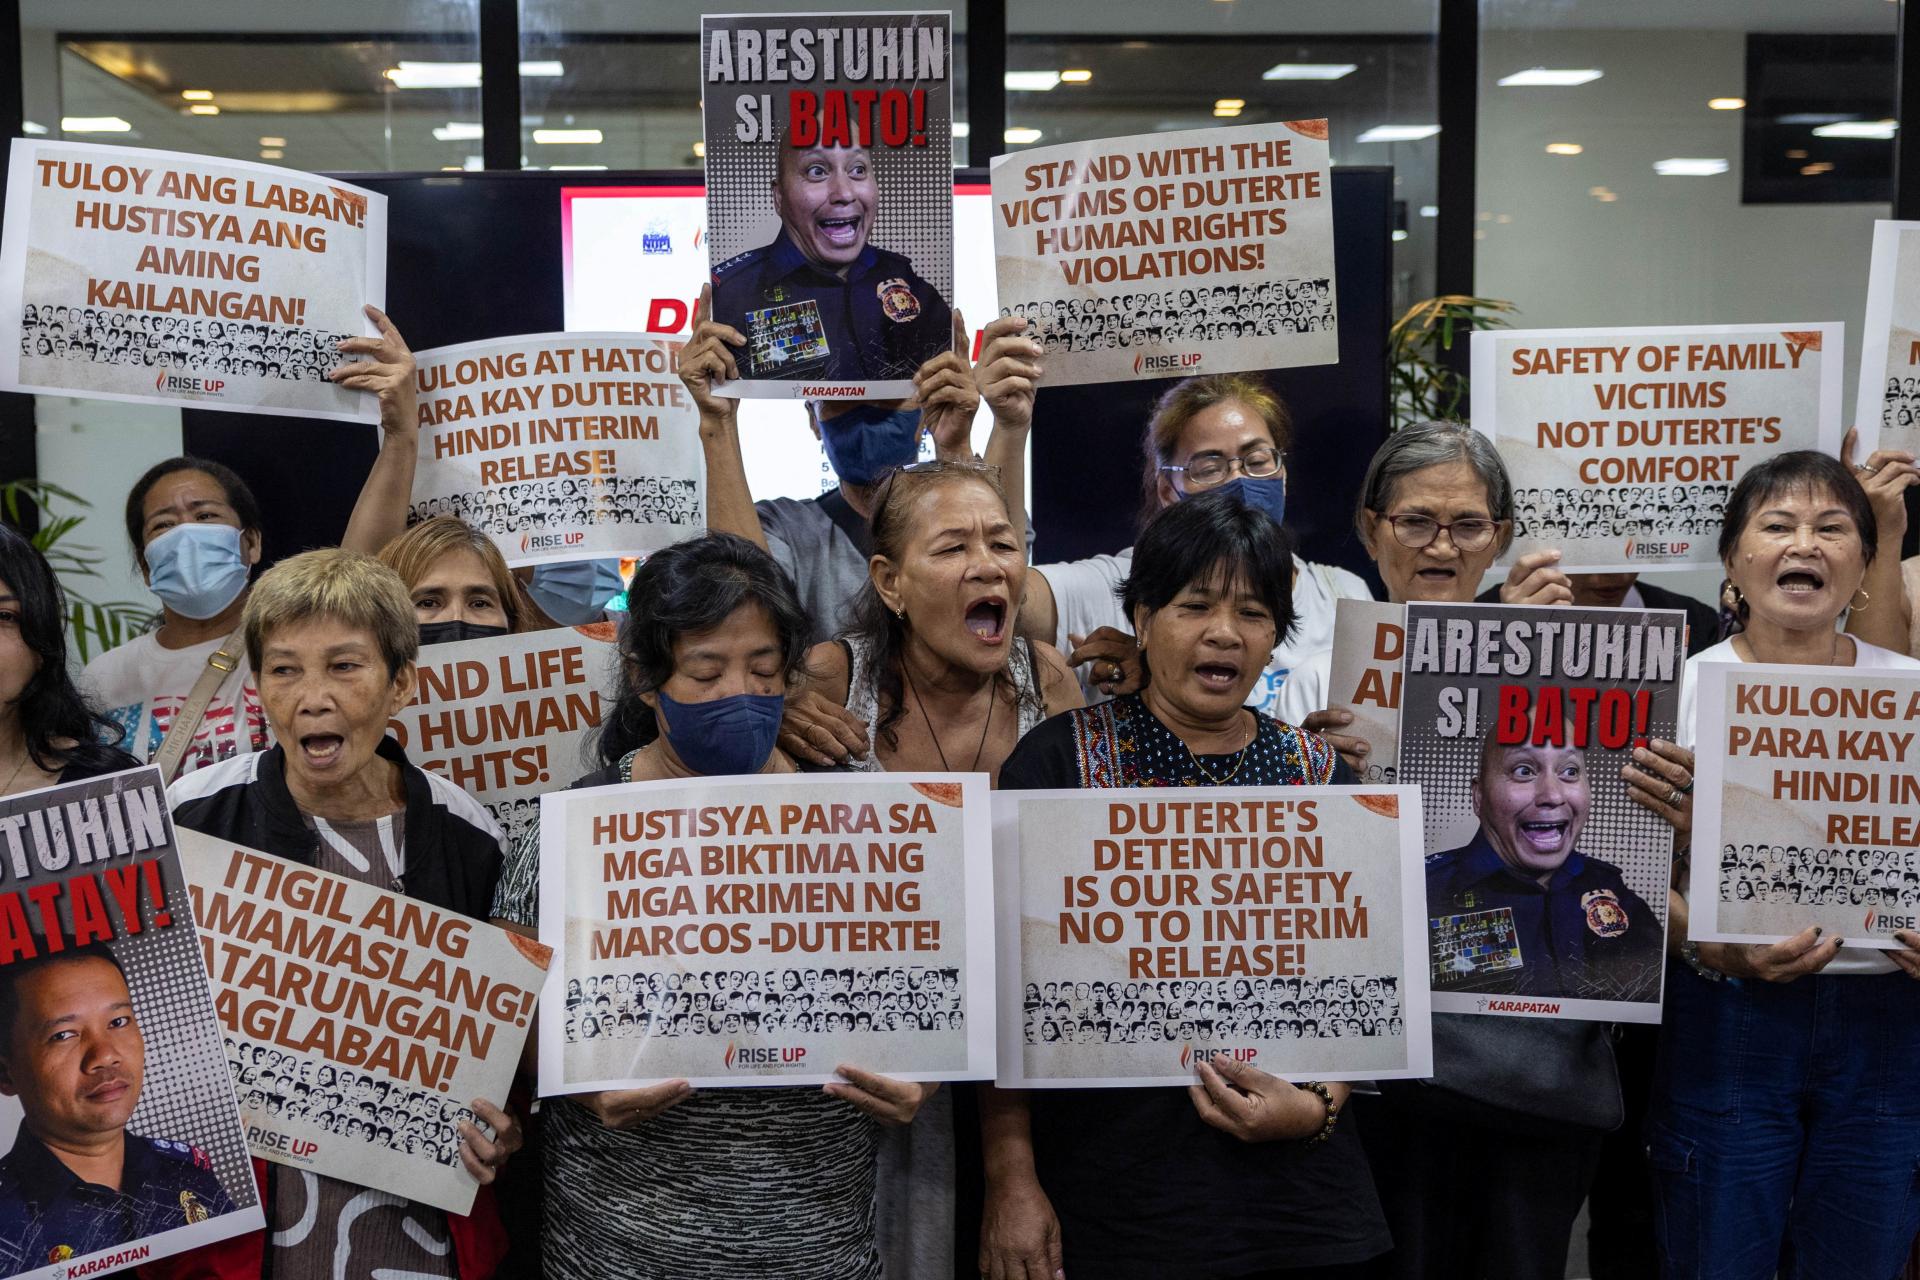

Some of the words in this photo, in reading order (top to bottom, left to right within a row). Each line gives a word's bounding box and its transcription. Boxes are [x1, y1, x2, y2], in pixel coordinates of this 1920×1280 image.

[708, 27, 945, 82] ARESTUHIN
[736, 94, 772, 143] SI
[790, 89, 927, 148] BATO!
[1025, 154, 1131, 192] STAND
[1137, 146, 1225, 177] WITH
[1231, 139, 1292, 170] THE
[37, 159, 153, 195] TULOY
[157, 171, 236, 205] ANG
[246, 181, 365, 229] LABAN!
[1001, 187, 1127, 228] VICTIMS
[1133, 183, 1175, 212] OF
[1182, 171, 1321, 209] DUTERTE
[75, 201, 243, 244] HUSTISYA
[248, 220, 326, 253] ANG
[1036, 218, 1164, 256] HUMAN
[1172, 208, 1287, 243] RIGHTS
[136, 246, 259, 282] AMING
[1060, 243, 1265, 286] VIOLATIONS!
[87, 279, 306, 326] KAILANGAN!
[416, 353, 527, 394] ULONG
[534, 349, 575, 375] AT
[1145, 355, 1179, 369] RISE
[1181, 353, 1202, 366] UP
[1512, 346, 1630, 376] SAFETY
[1637, 345, 1680, 372] OF
[1688, 342, 1807, 371] FAMILY
[167, 376, 201, 391] RISE
[204, 380, 225, 392] UP
[482, 385, 544, 416] KAY
[551, 382, 692, 412] DUTERTE,
[802, 386, 865, 397] KARAPATAN
[1594, 381, 1726, 410] VICTIMS
[434, 423, 520, 460] HINDI
[529, 415, 659, 444] INTERIM
[1537, 420, 1613, 449] NOT
[1617, 417, 1781, 447] DUTERTE'S
[480, 450, 616, 485] RELEASE!
[1580, 455, 1739, 484] COMFORT
[531, 534, 562, 548] RISE
[565, 532, 584, 544] UP
[1636, 543, 1668, 554] RISE
[1670, 542, 1689, 553] UP
[1410, 618, 1676, 682] ARESTUHIN
[405, 660, 490, 707] ND
[499, 646, 585, 693] LIFE
[1437, 686, 1479, 738] SI
[1497, 686, 1653, 750] BATO!
[1736, 684, 1896, 720] KULONG
[419, 690, 600, 752] HUMAN
[1729, 726, 1830, 759] PARA
[1838, 730, 1915, 762] KAY
[1773, 770, 1880, 803] HINDI
[0, 785, 167, 881] TUHIN
[593, 805, 772, 846] HUSTISYA
[780, 804, 882, 835] PARA
[889, 803, 937, 834] SA
[1108, 800, 1318, 836] DUTERTE'S
[603, 846, 692, 883] MGA
[700, 843, 860, 876] BIKTIMA
[868, 842, 924, 874] NG
[1094, 836, 1323, 872] DETENTION
[224, 850, 352, 924] ITIGIL
[359, 895, 473, 958] ANG
[607, 885, 697, 921] MGA
[705, 882, 860, 915] KRIMEN
[864, 881, 921, 912] NG
[1064, 875, 1099, 908] IS
[1110, 873, 1202, 907] OUR
[1211, 871, 1362, 909] SAFETY,
[1059, 911, 1124, 944] NO
[1134, 909, 1190, 943] TO
[1203, 906, 1369, 942] INTERIM
[1877, 915, 1915, 930] RISE
[1129, 943, 1305, 979] RELEASE!
[1488, 1000, 1560, 1015] KARAPATAN
[738, 1047, 778, 1063] RISE
[782, 1047, 806, 1062] UP
[1235, 1048, 1258, 1062] UP
[247, 1125, 290, 1151] RISE
[291, 1138, 318, 1157] UP
[67, 1244, 149, 1279] KARAPATAN
